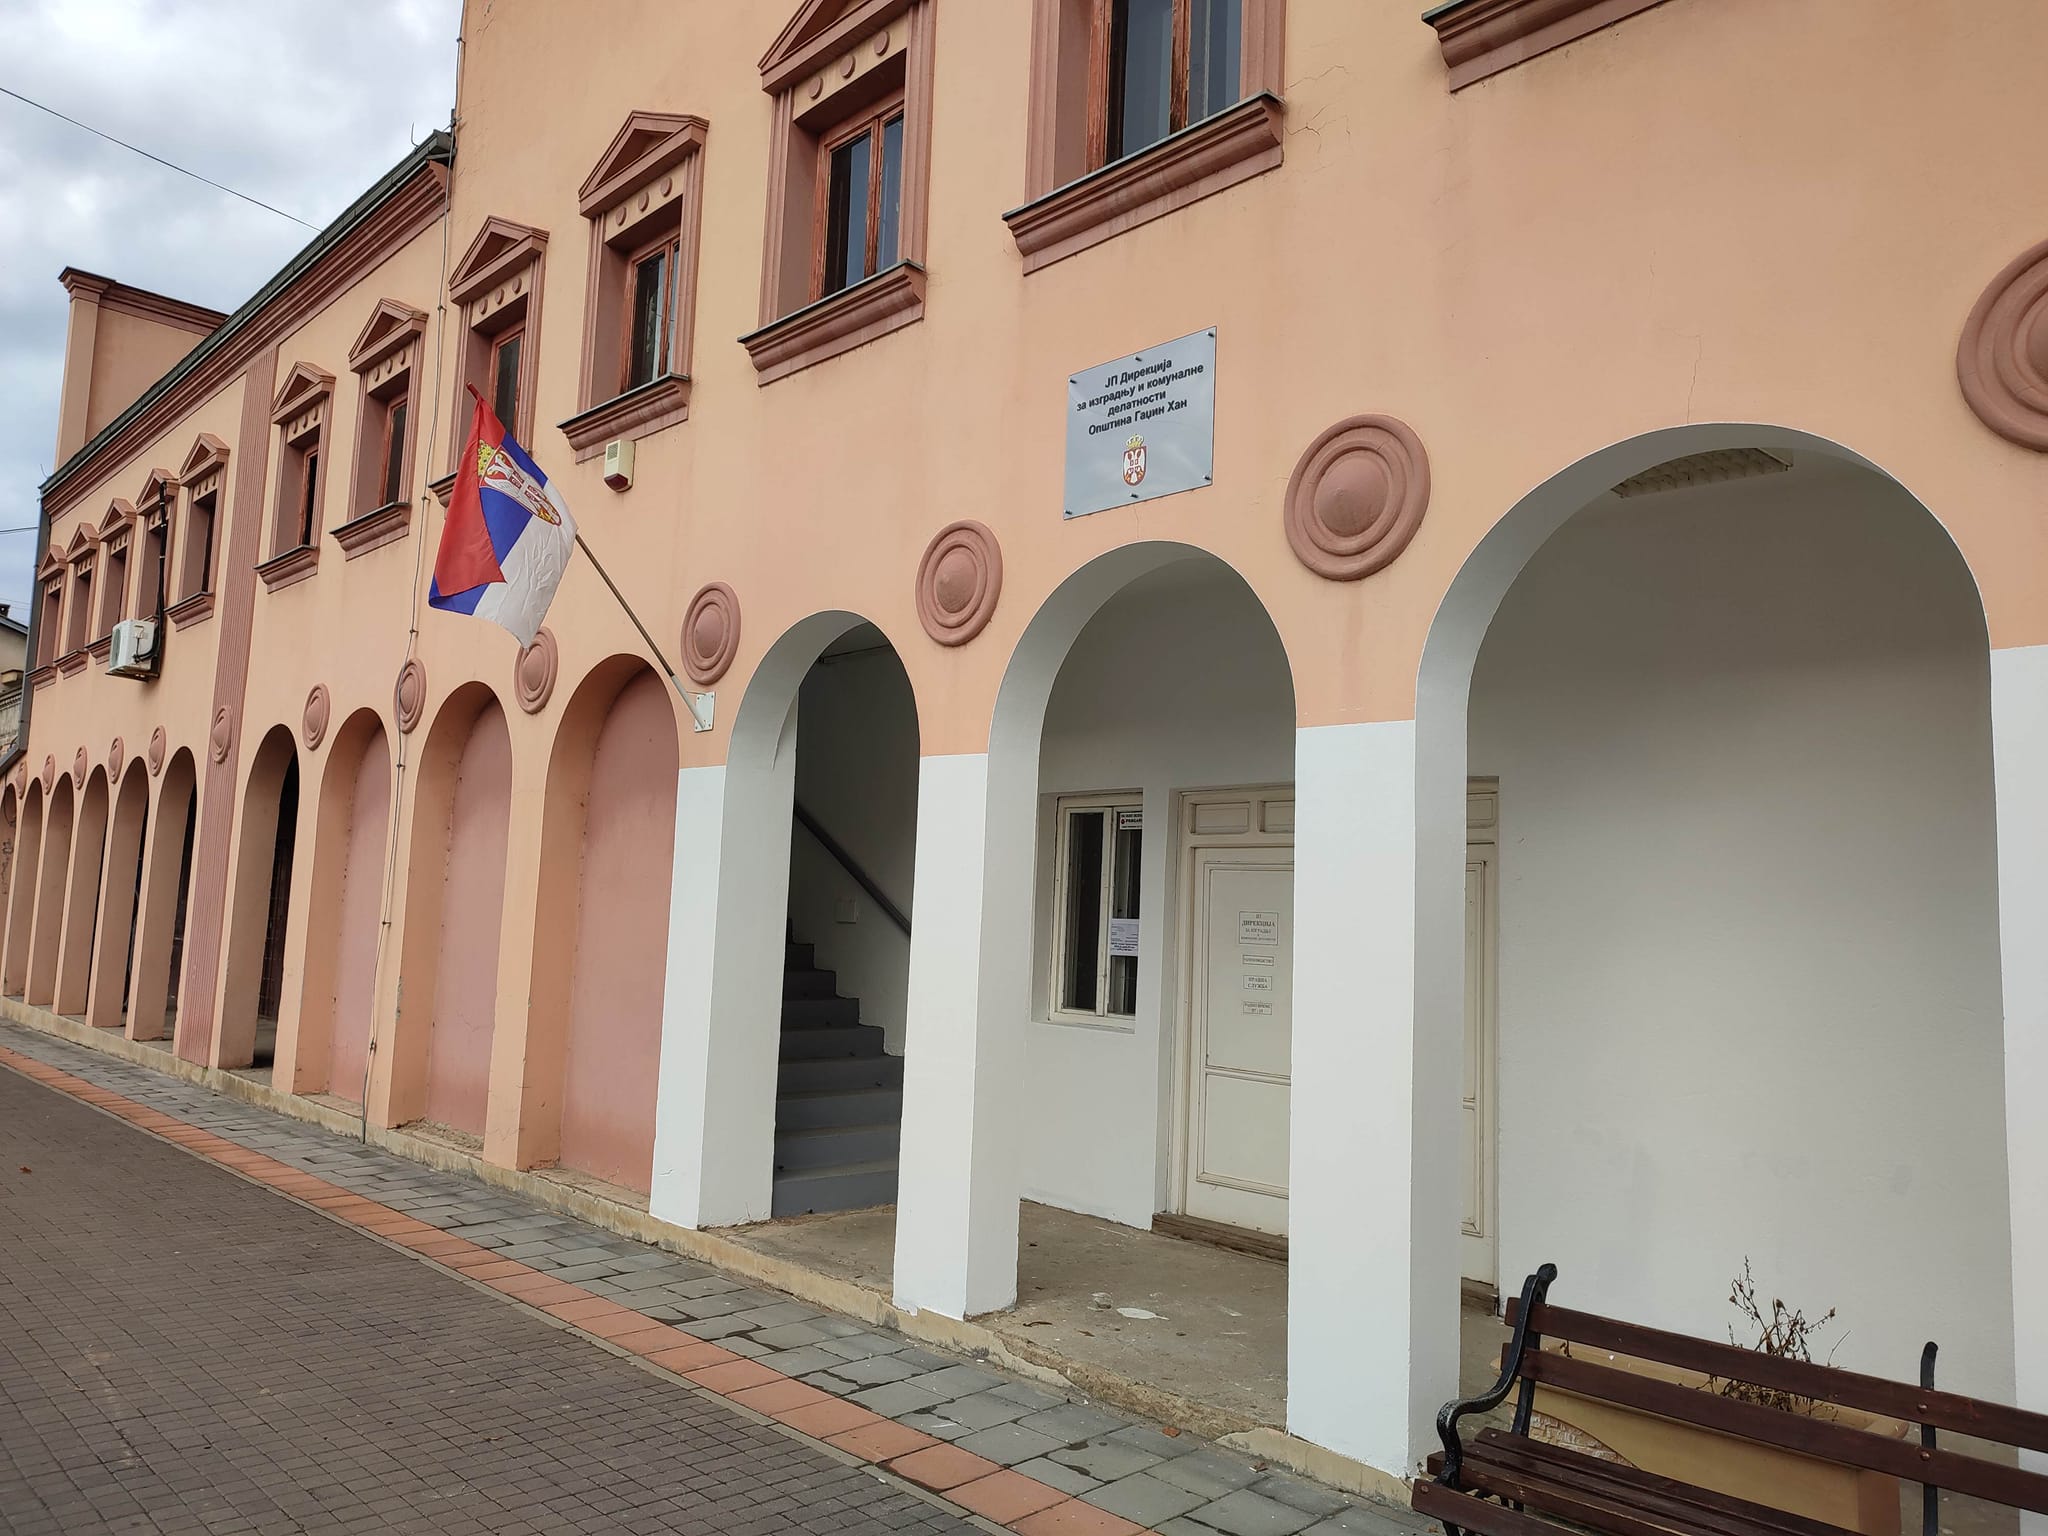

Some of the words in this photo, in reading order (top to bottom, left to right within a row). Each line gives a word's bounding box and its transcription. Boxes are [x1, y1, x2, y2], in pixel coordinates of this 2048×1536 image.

[1077, 402, 1087, 412] за
[1089, 386, 1136, 405] изградњу
[1138, 383, 1145, 392] и
[1147, 364, 1204, 389] комуналне
[1105, 375, 1118, 388] ЈП
[1120, 359, 1172, 385] Дирекција
[1088, 416, 1132, 435] Општина
[1135, 406, 1165, 422] Гаџин
[1167, 399, 1187, 412] Хан
[1107, 390, 1166, 417] делатности
